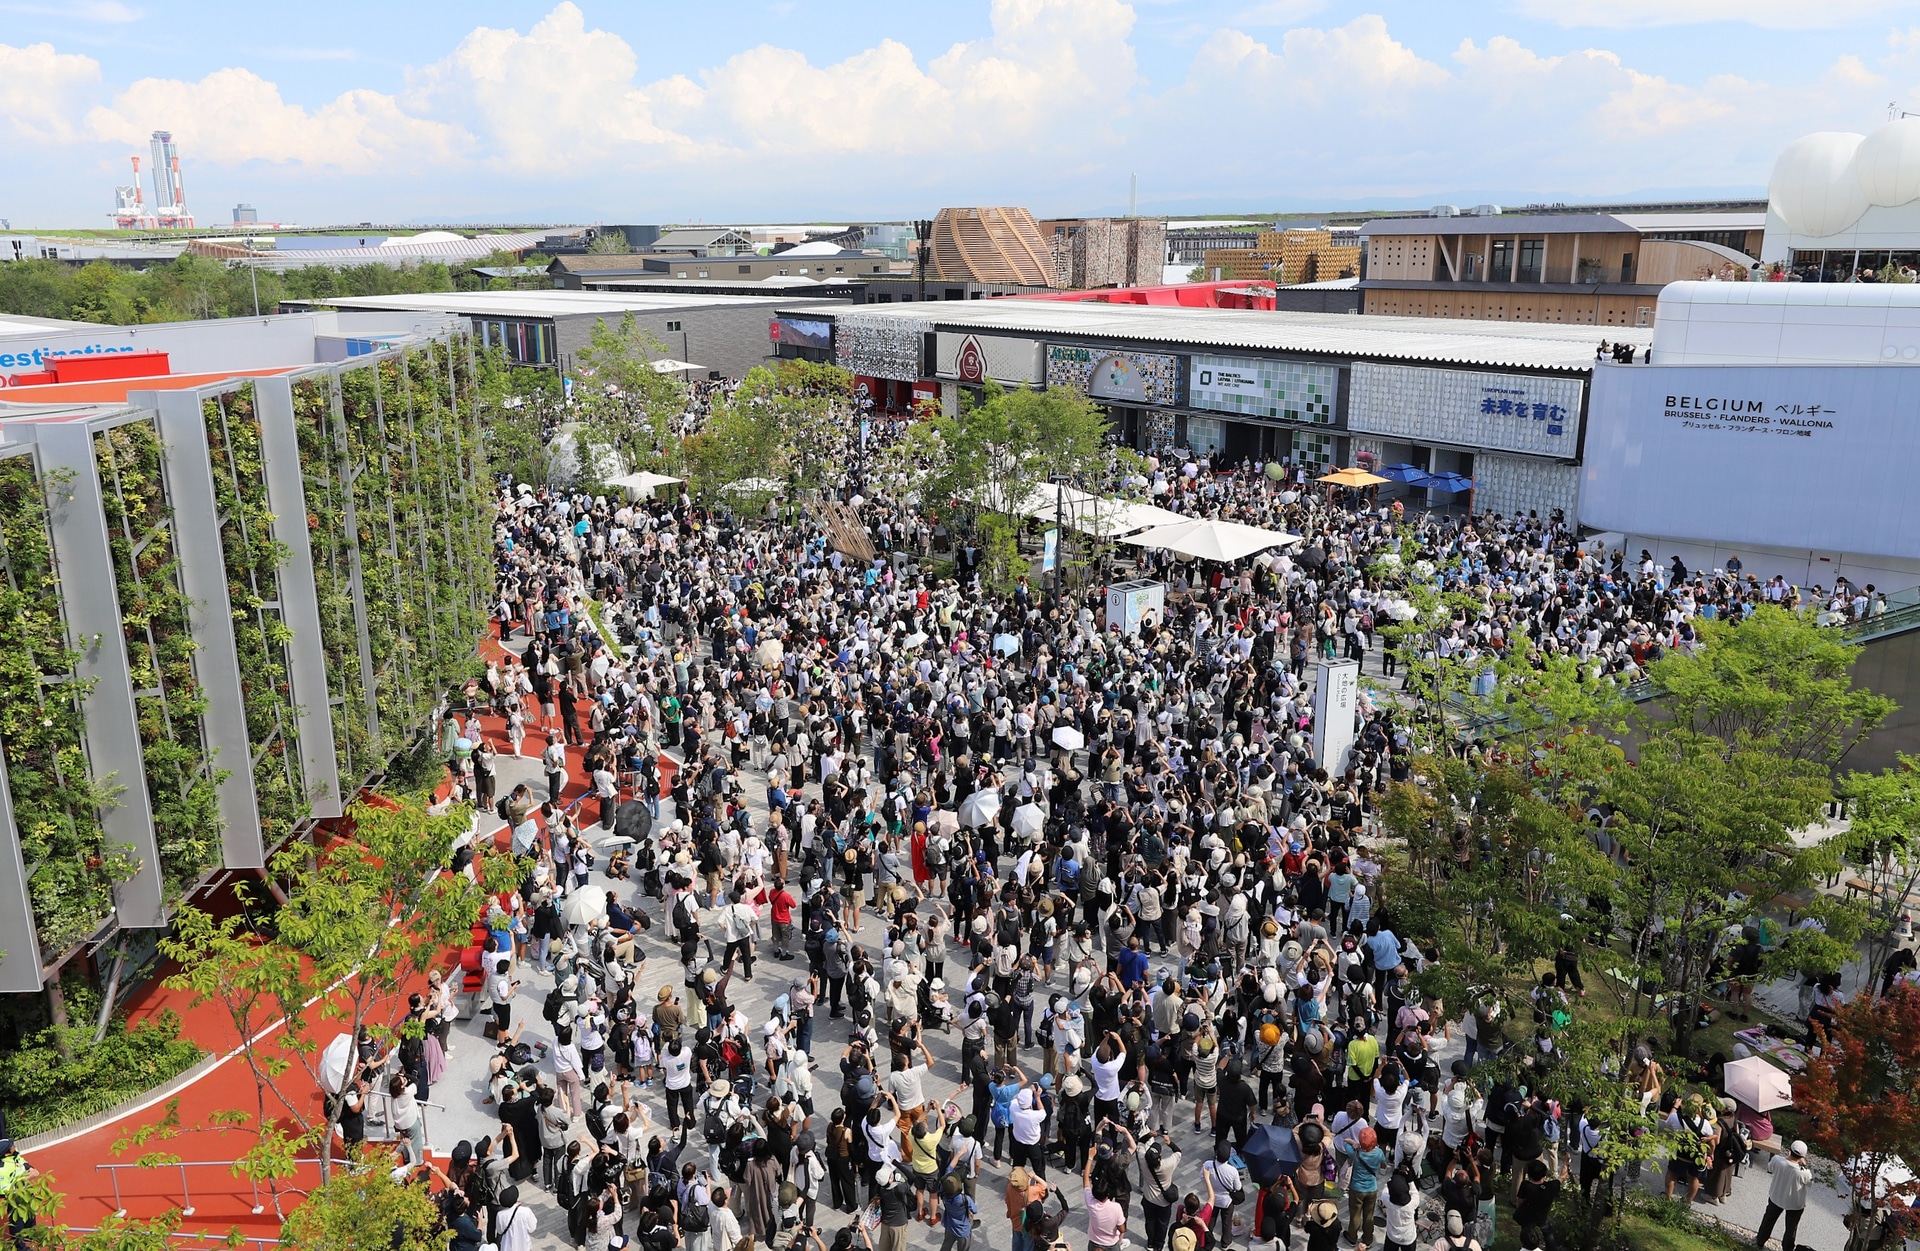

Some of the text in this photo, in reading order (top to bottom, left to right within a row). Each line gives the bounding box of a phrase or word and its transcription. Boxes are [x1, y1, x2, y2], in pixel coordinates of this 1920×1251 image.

[1480, 397, 1567, 422] 未来を育む
[1665, 395, 1763, 413] BELGIUM
[1775, 404, 1836, 417] ベルギー
[1664, 410, 1834, 429] BRUSSELS FLANDERS WALLONIA
